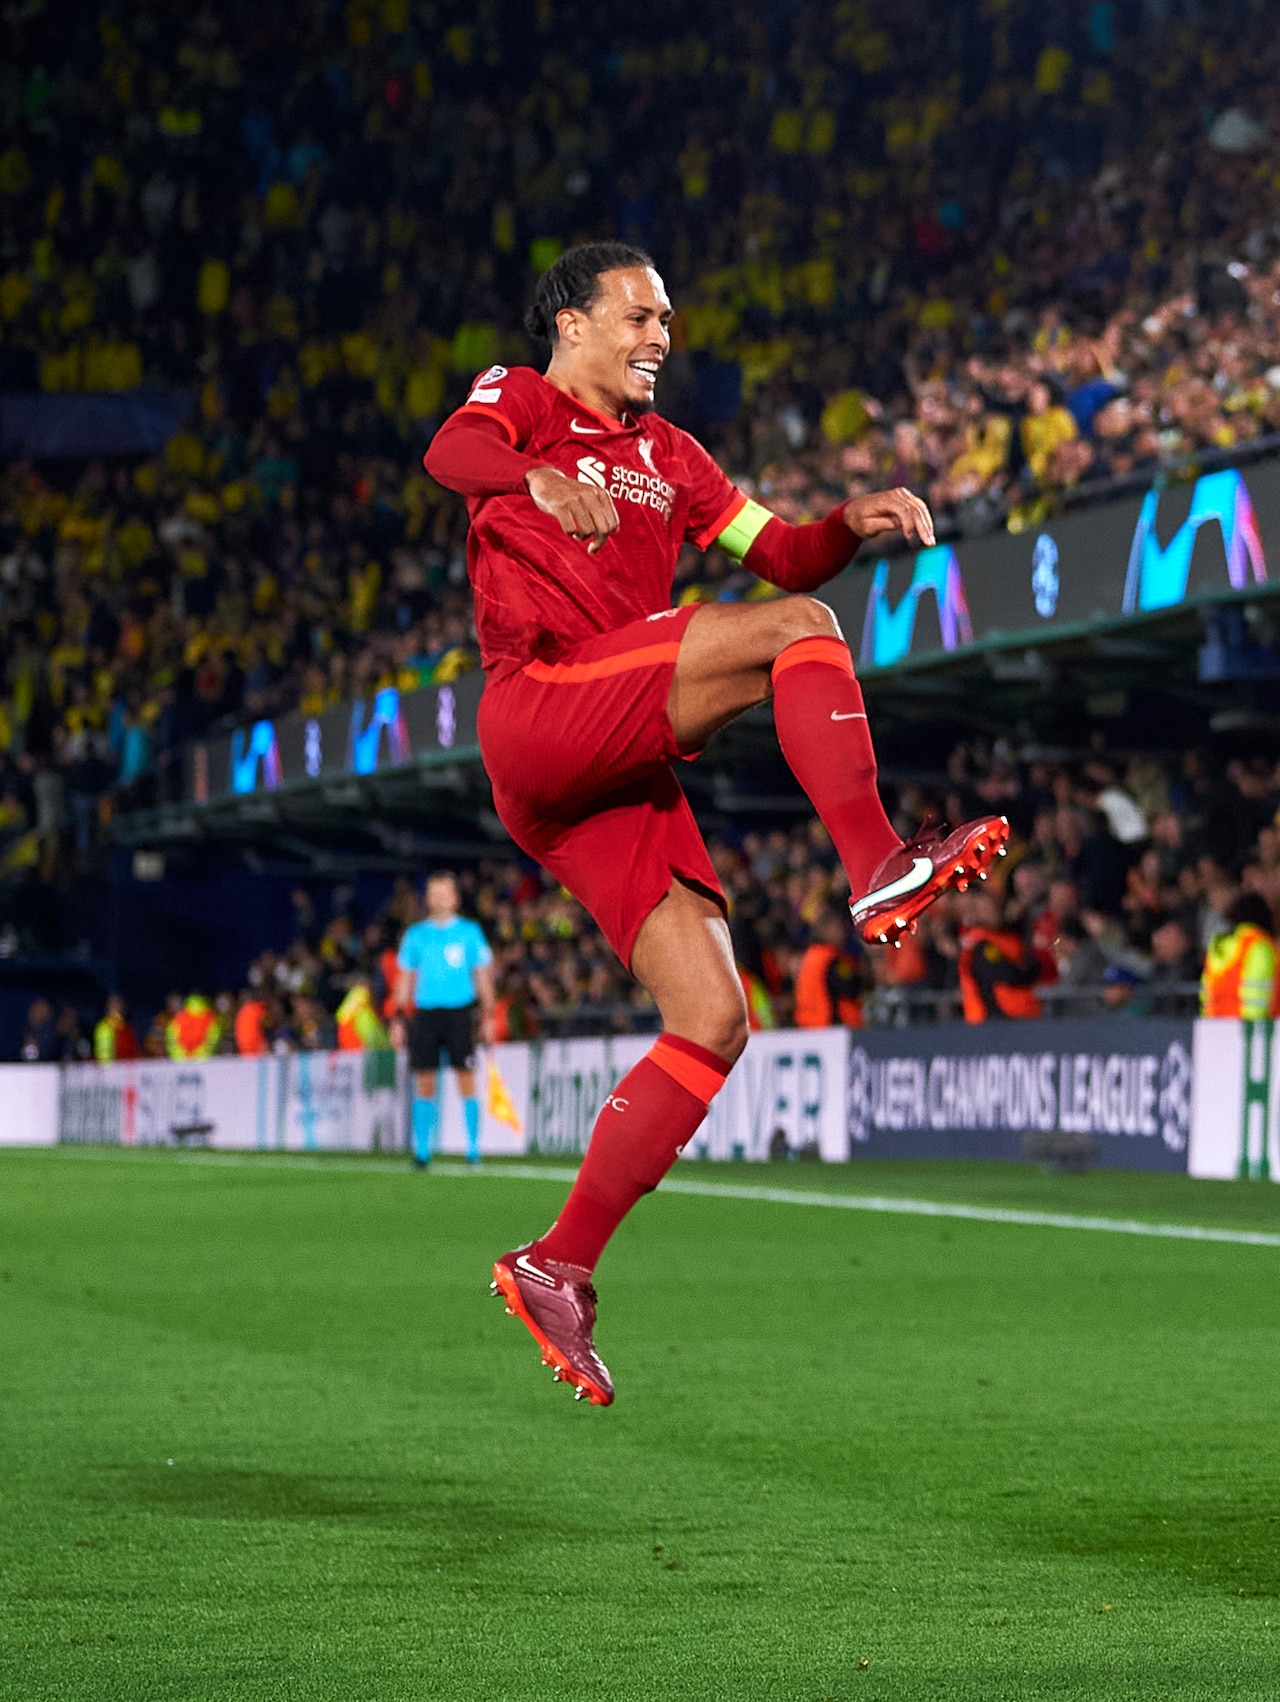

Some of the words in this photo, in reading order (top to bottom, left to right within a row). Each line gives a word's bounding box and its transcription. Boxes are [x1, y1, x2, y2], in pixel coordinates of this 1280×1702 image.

[873, 1057, 925, 1131] UEFA
[929, 1052, 1056, 1131] CHAMPIONS
[1060, 1053, 1158, 1136] LEAGUE
